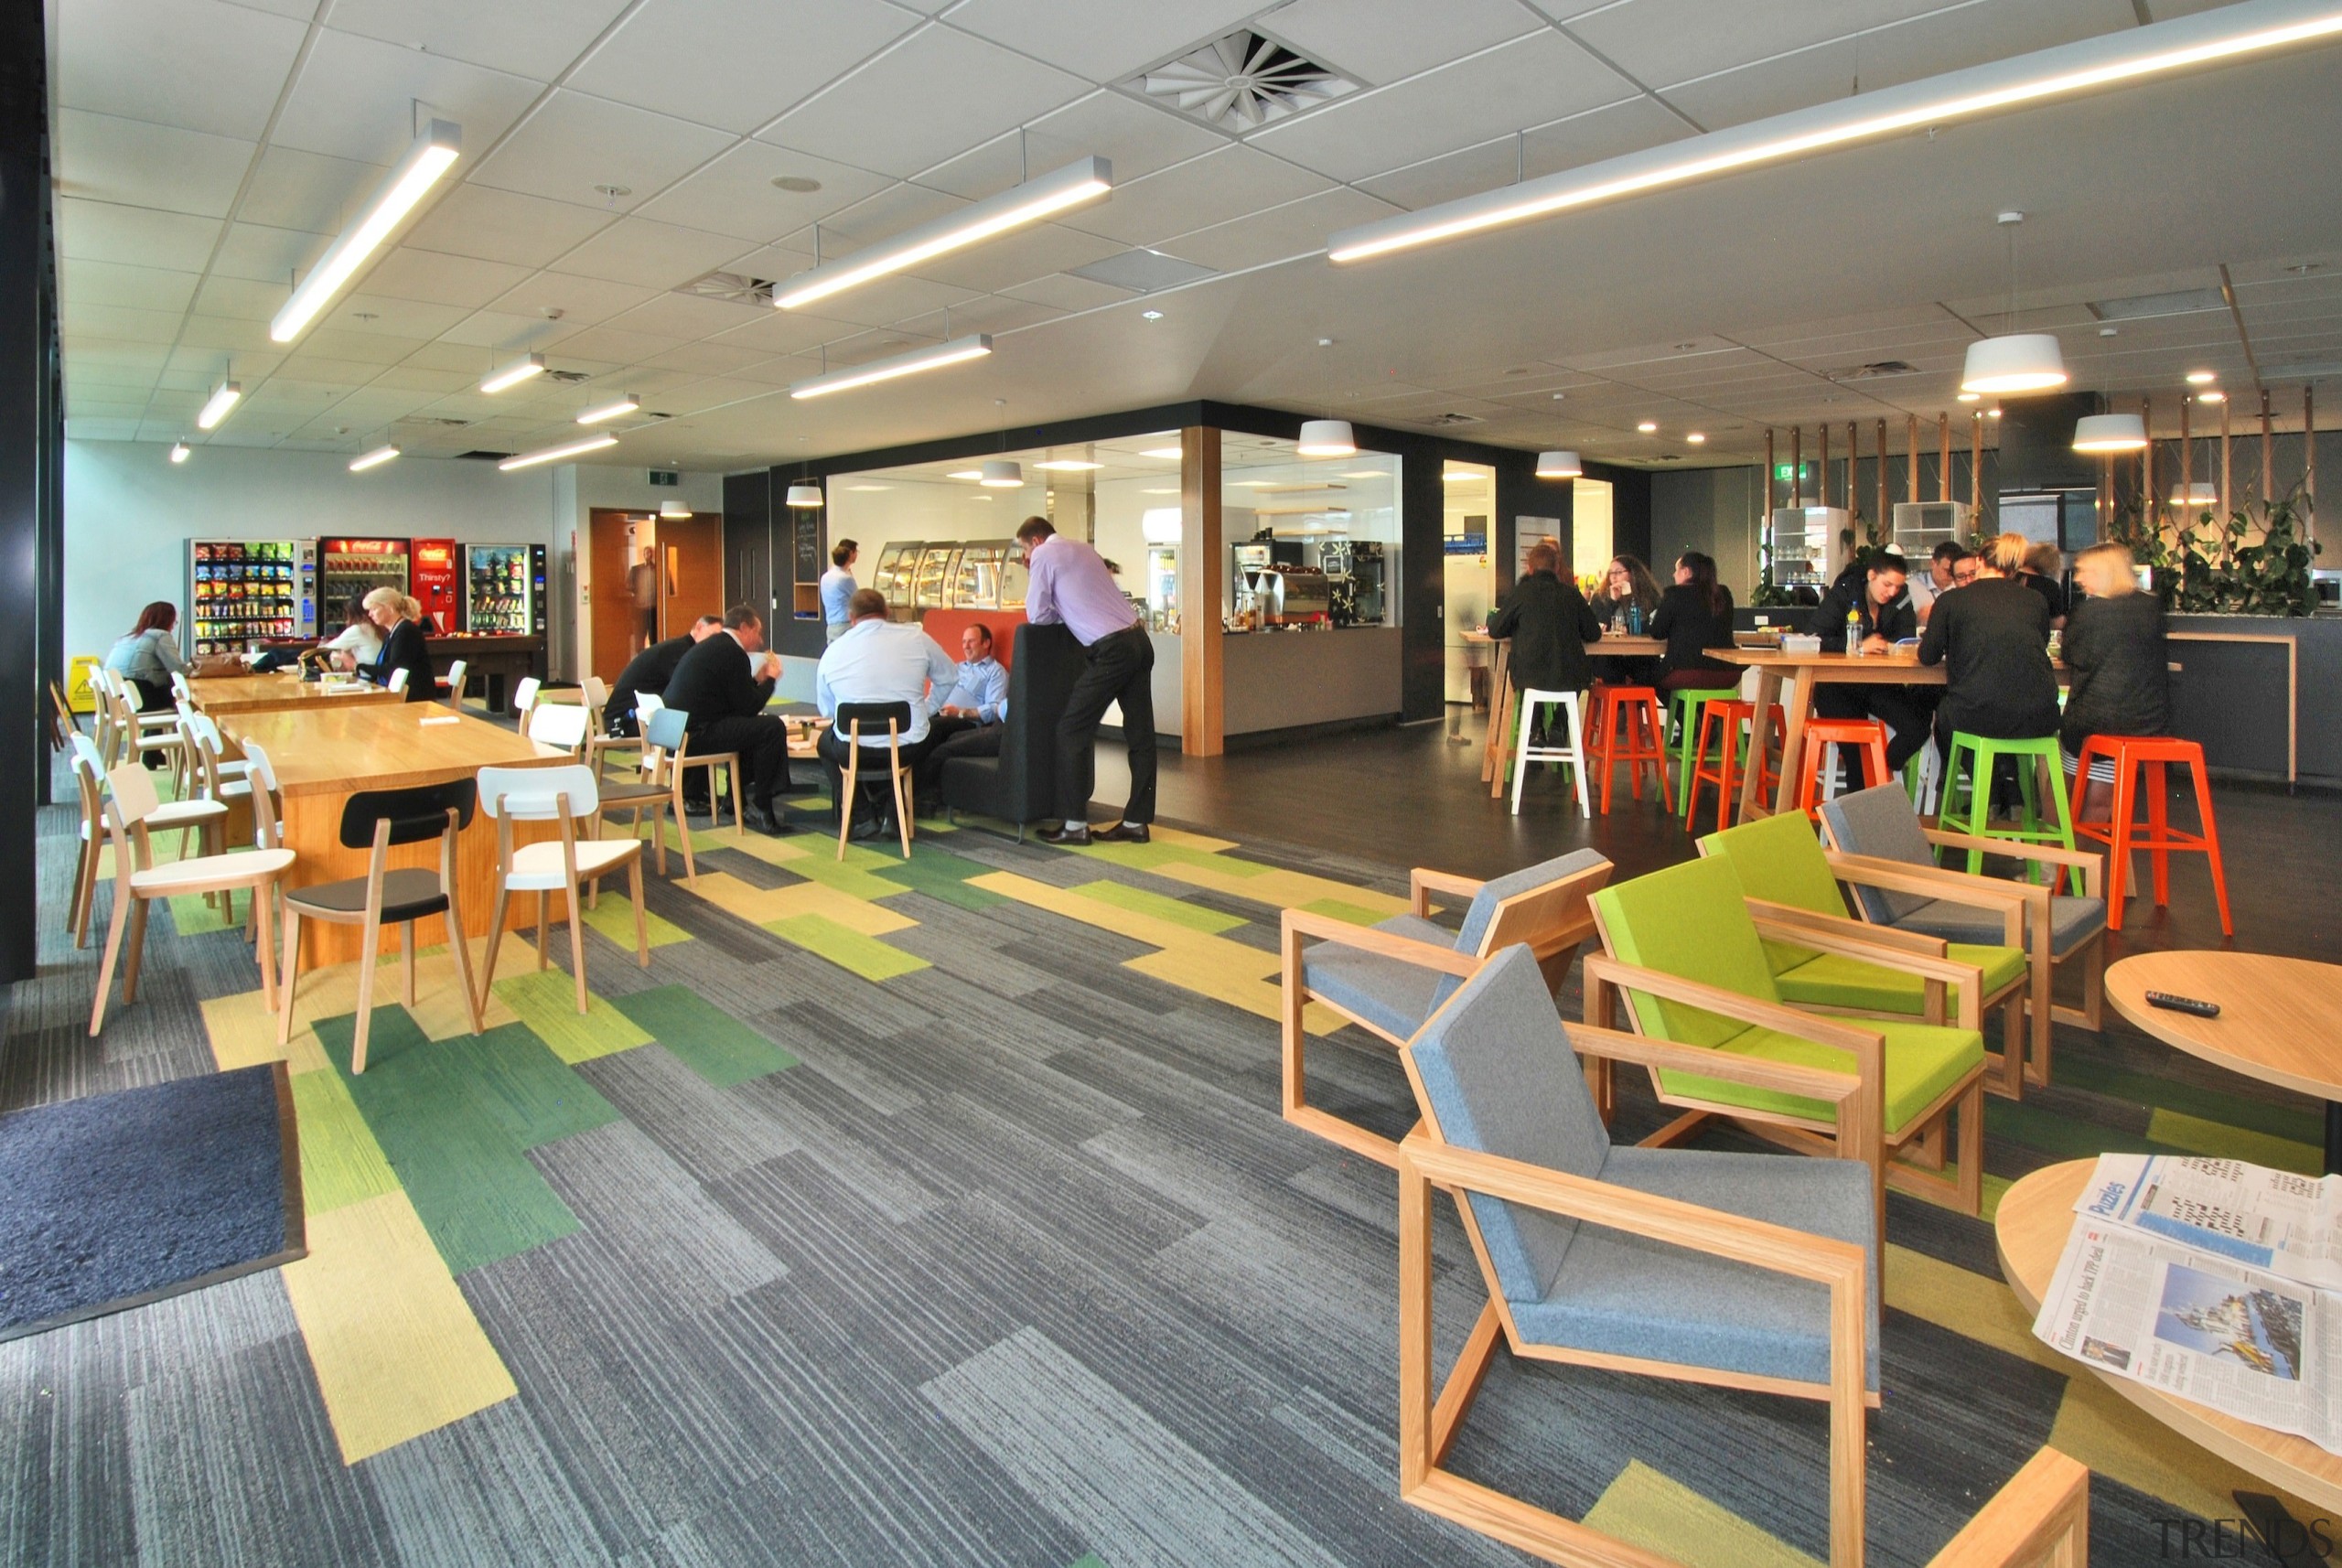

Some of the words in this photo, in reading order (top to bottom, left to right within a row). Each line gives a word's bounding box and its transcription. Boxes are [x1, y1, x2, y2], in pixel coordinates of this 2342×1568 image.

[419, 574, 451, 583] Thirsty?
[2088, 1181, 2126, 1217] Puzzles
[2078, 1291, 2090, 1301] to
[2071, 1298, 2090, 1322] urged
[2057, 1321, 2080, 1351] Clinton
